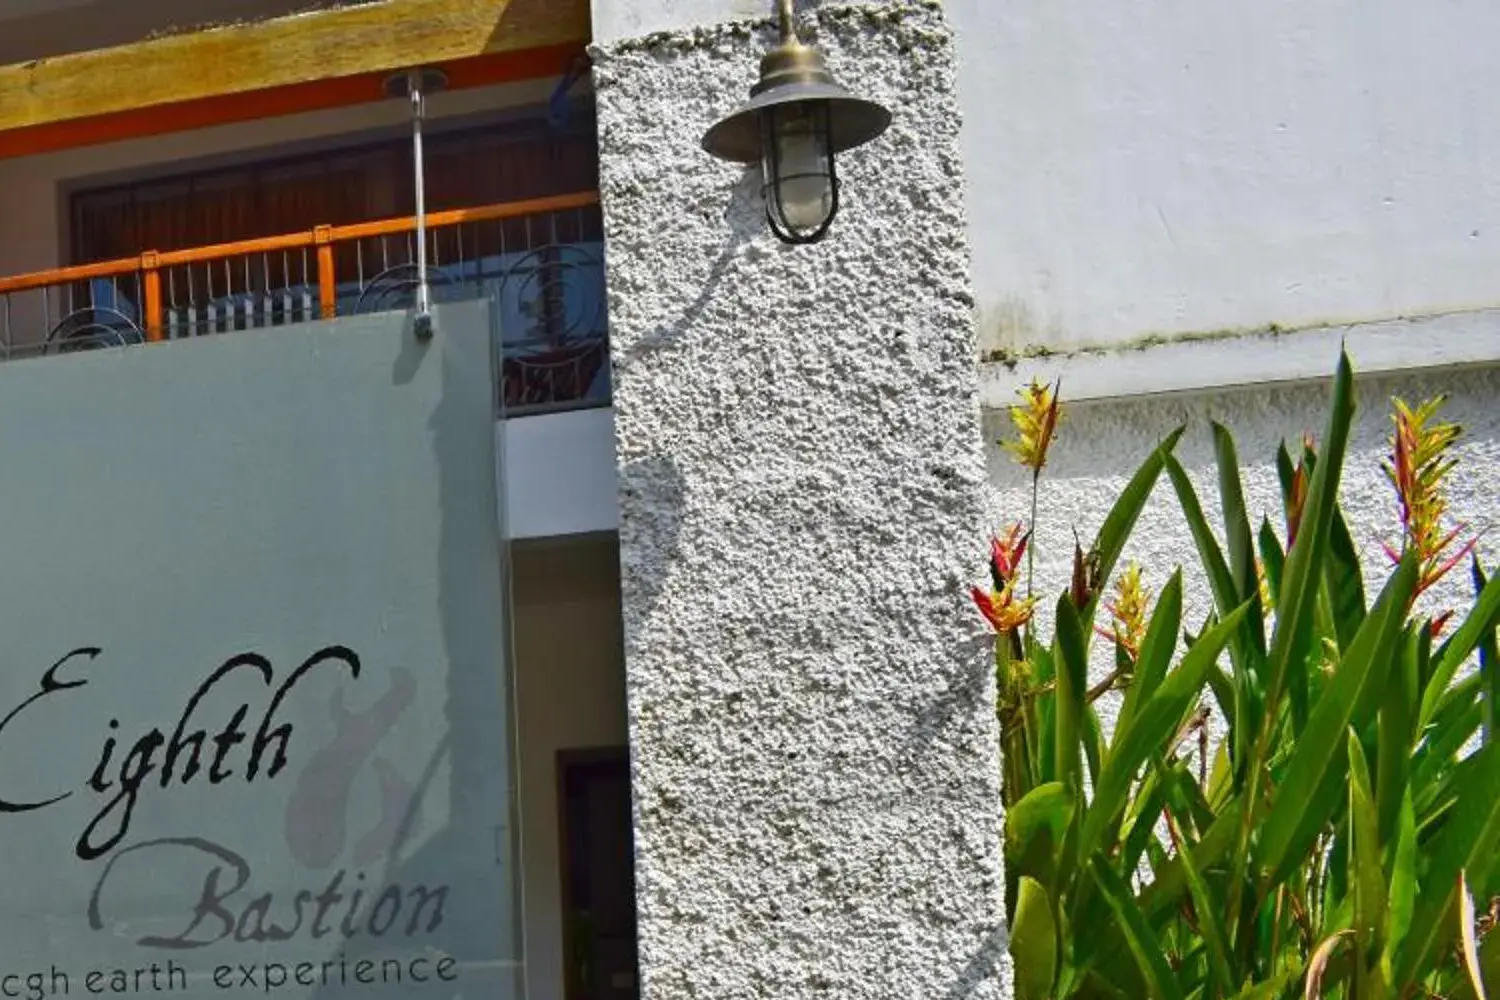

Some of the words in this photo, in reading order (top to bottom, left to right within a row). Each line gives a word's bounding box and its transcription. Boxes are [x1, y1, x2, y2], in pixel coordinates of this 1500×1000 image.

[87, 836, 451, 950] Bastion
[84, 960, 188, 994] earth
[212, 952, 459, 993] experience
